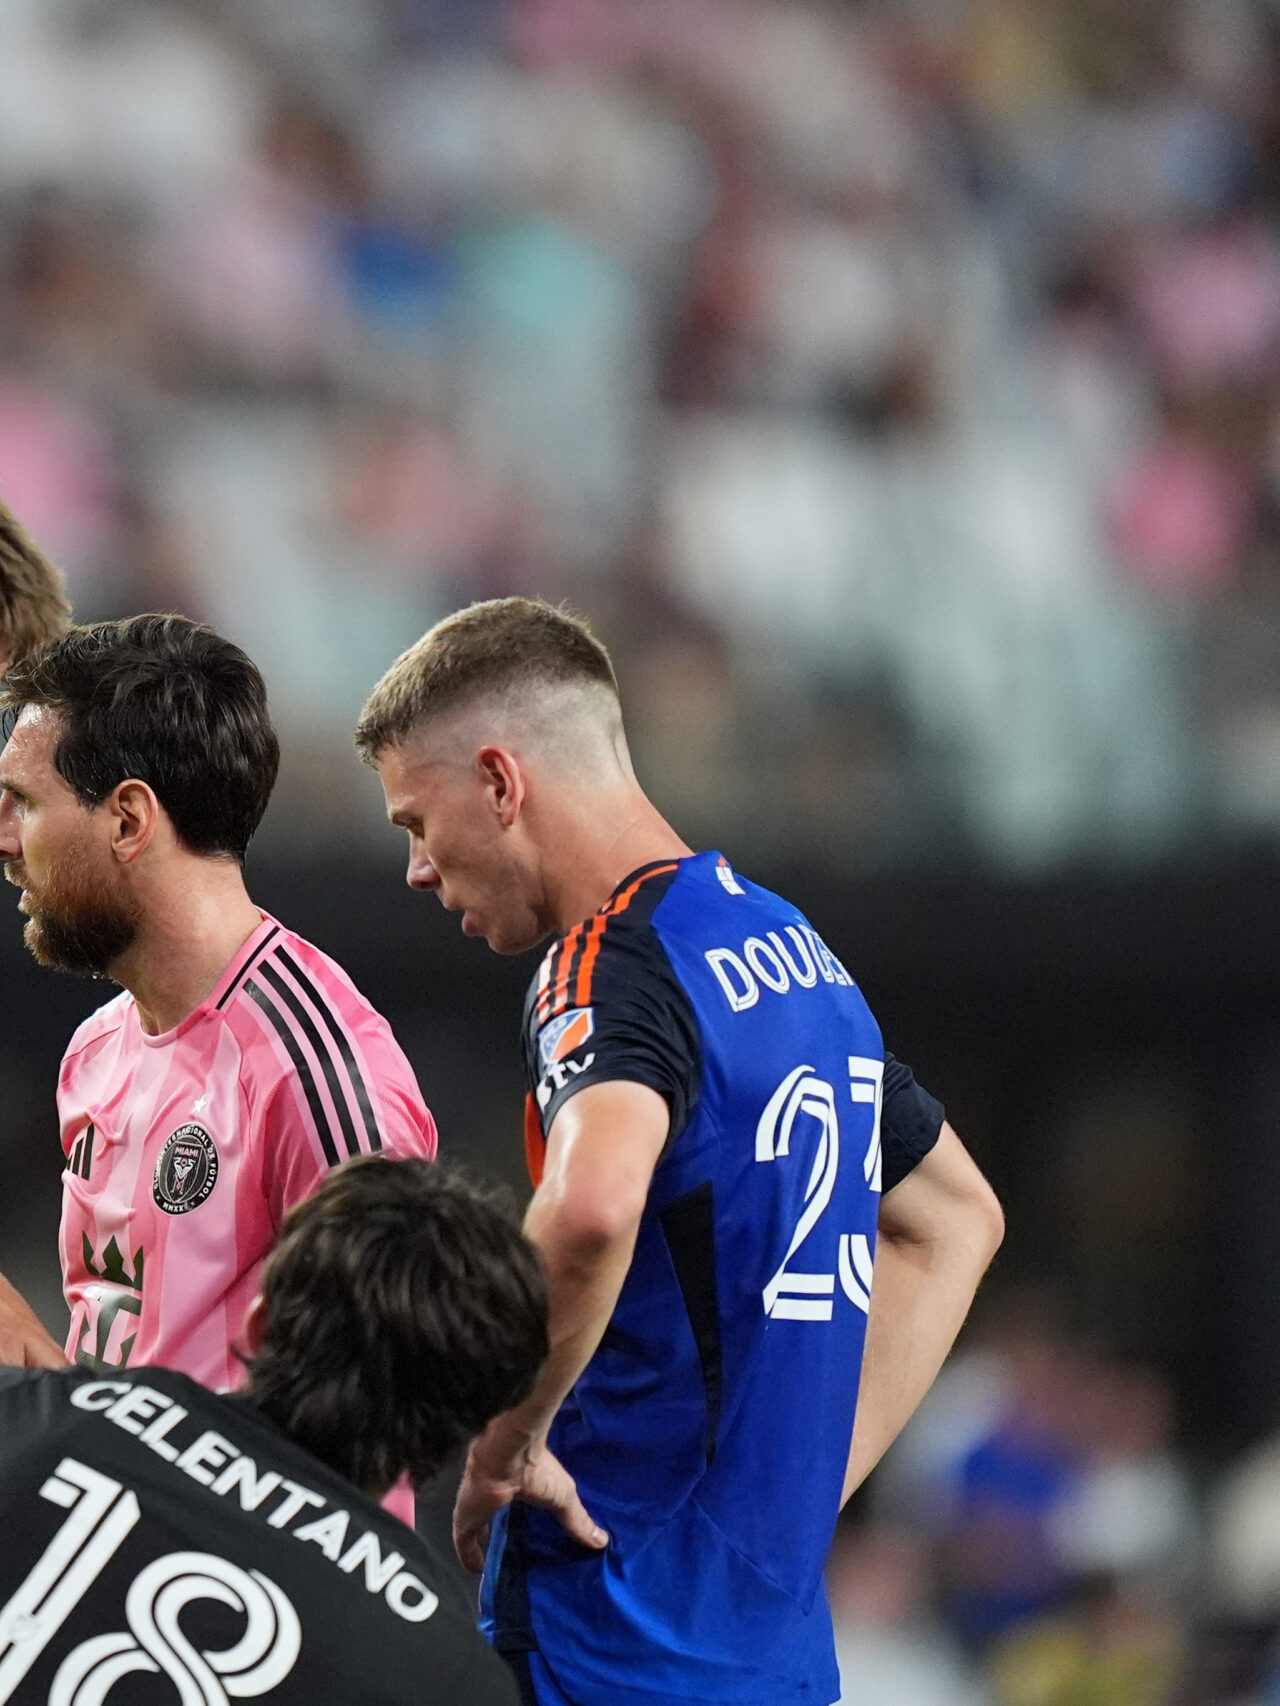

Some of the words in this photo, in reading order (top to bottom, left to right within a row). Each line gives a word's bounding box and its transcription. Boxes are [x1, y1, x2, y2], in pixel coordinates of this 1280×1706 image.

[547, 1052, 596, 1090] tv
[175, 1146, 199, 1157] MIAMI
[70, 1380, 439, 1623] CELENTANO
